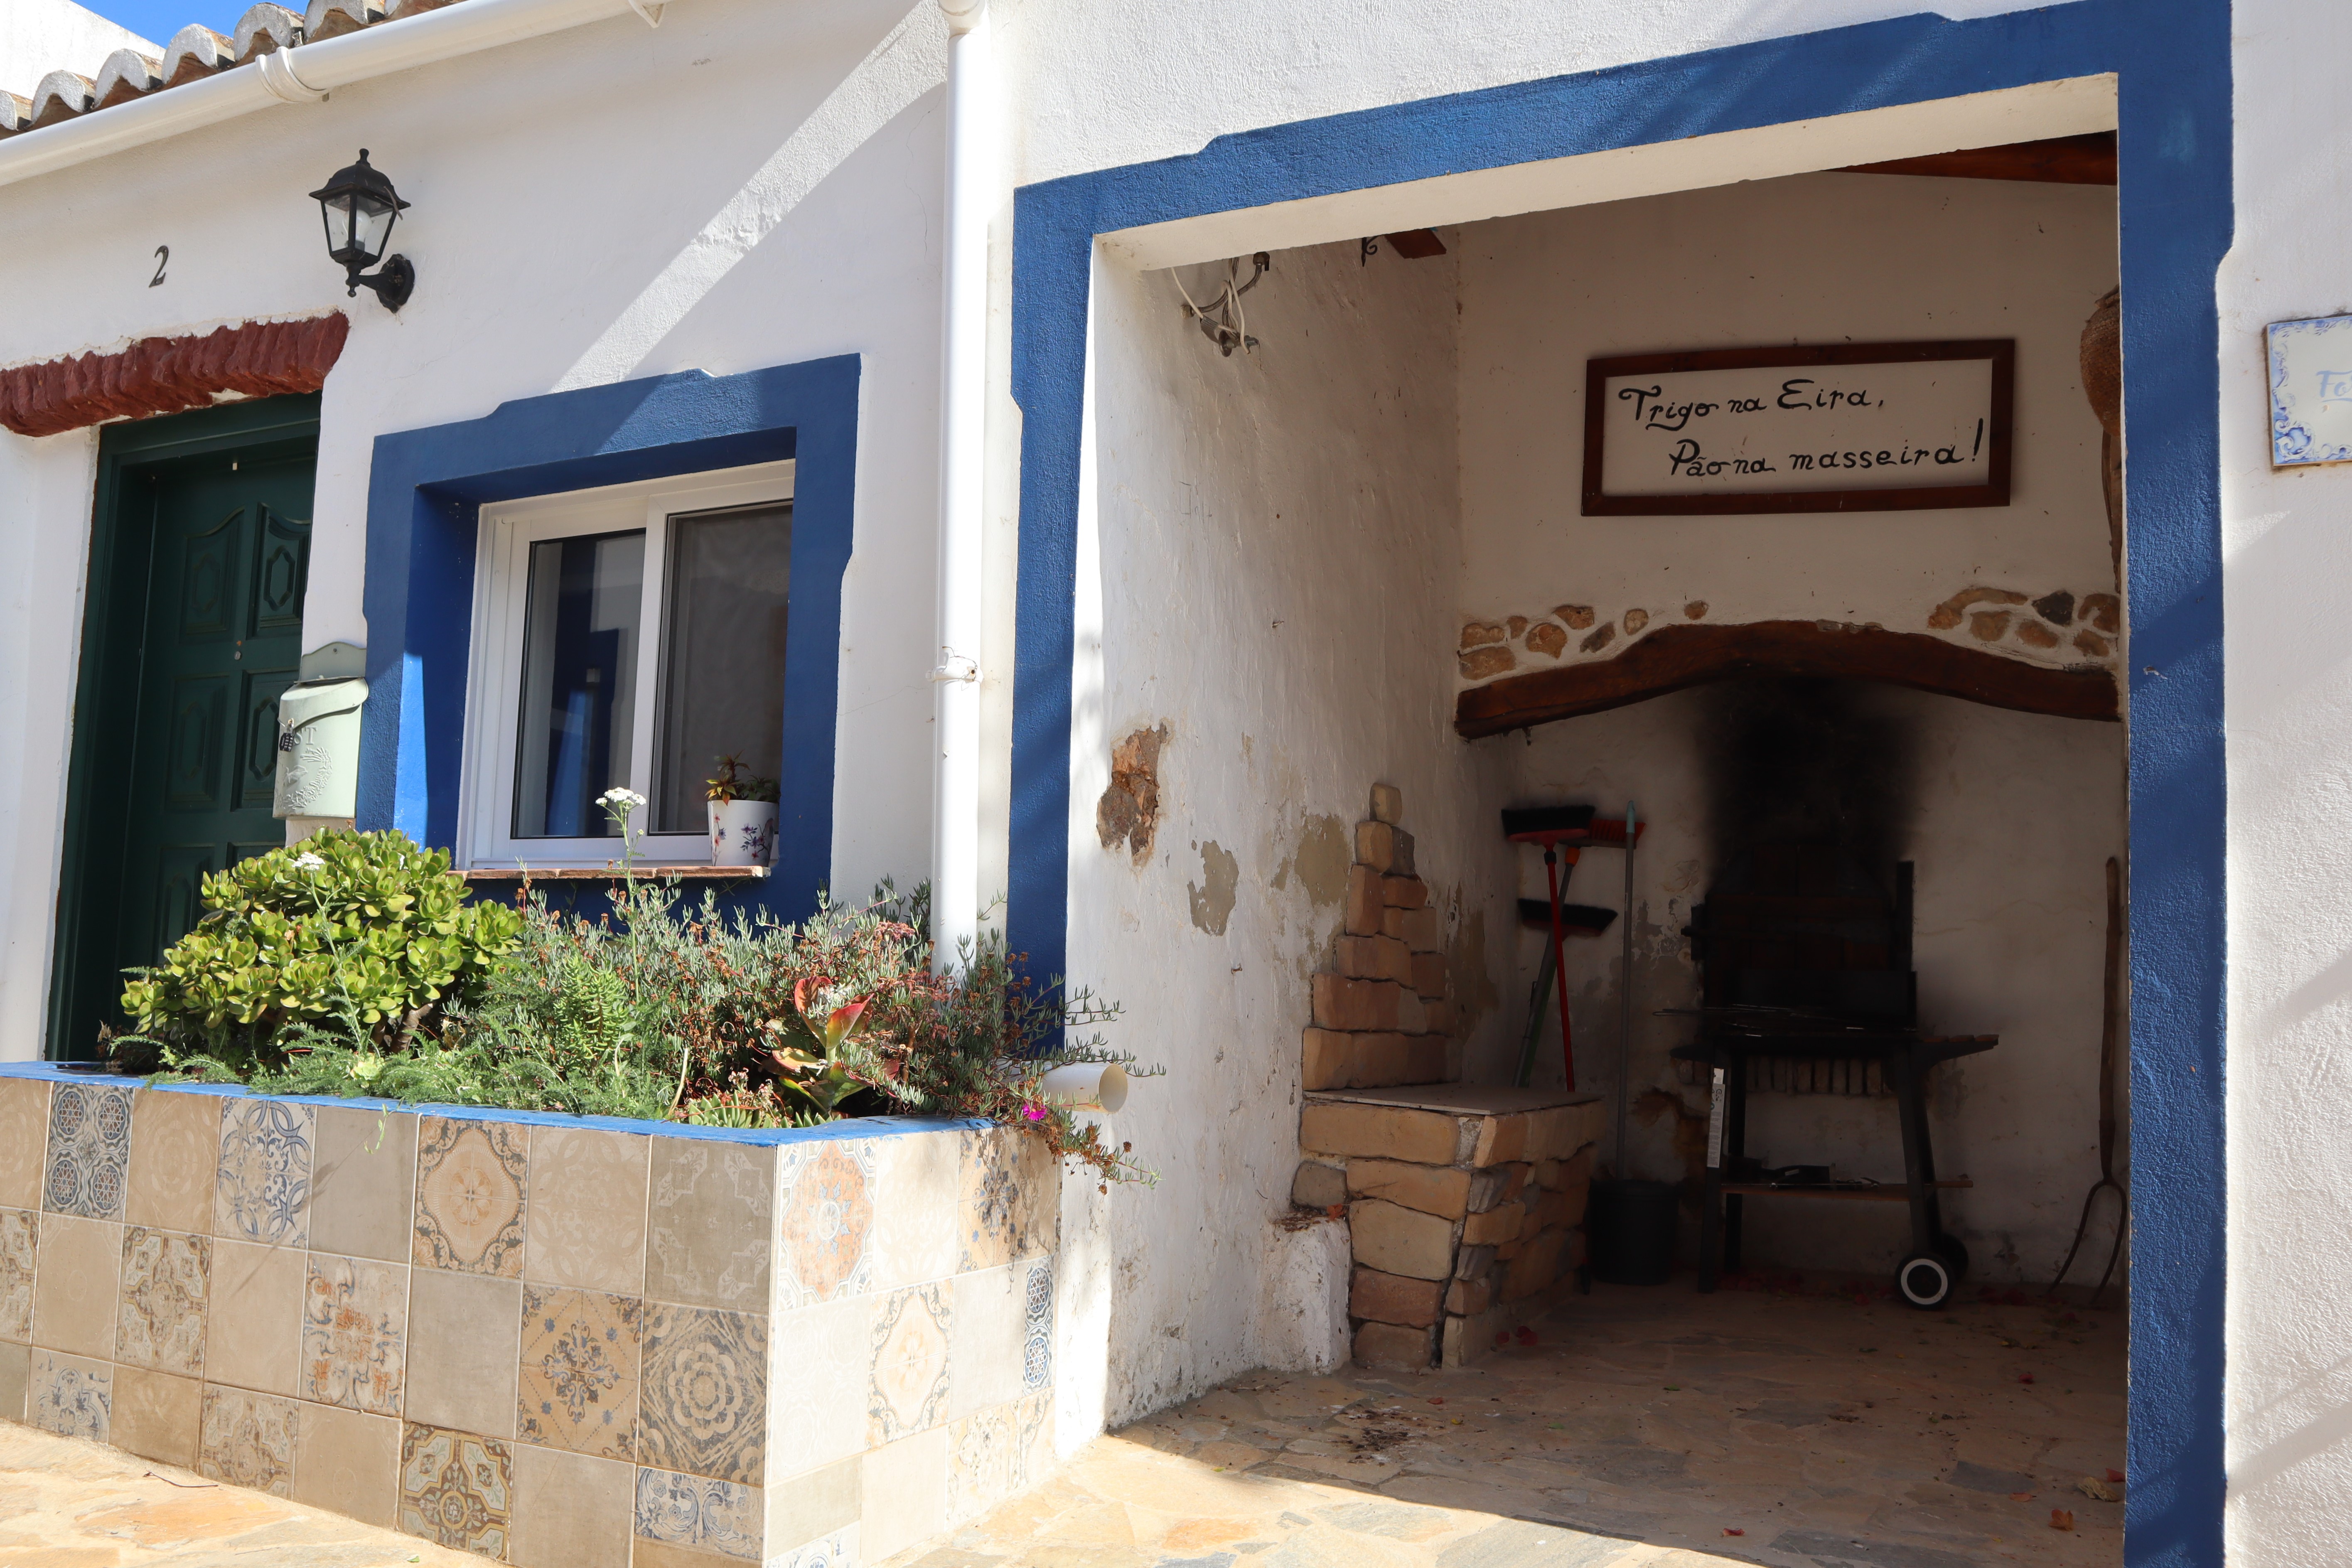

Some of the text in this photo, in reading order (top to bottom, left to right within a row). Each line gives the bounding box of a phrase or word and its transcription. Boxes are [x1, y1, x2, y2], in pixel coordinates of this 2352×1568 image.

[148, 245, 169, 288] 2
[2315, 370, 2352, 398] Fo
[1619, 385, 1719, 431] Trigo
[1728, 398, 1767, 413] na
[1669, 418, 1983, 477] Pão na masseira!
